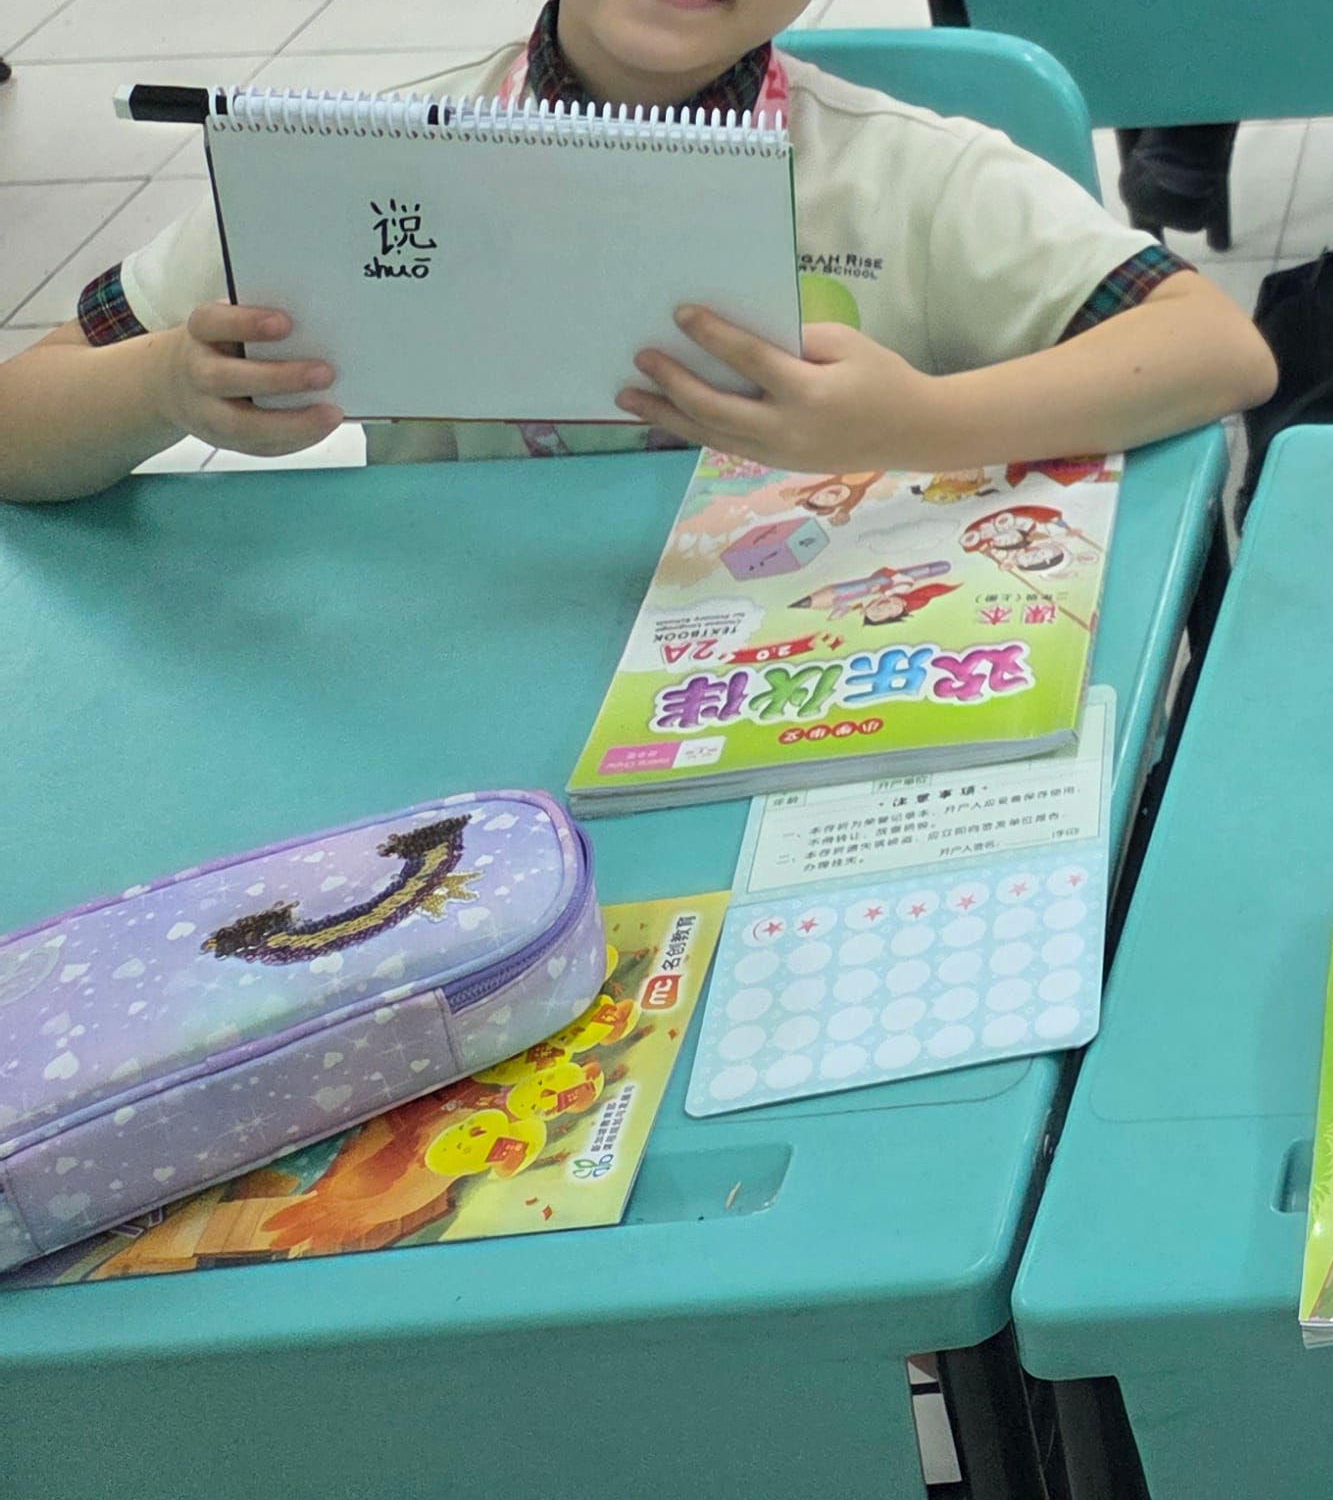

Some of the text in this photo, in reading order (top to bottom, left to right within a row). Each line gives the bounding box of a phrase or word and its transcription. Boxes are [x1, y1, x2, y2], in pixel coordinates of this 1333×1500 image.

[370, 198, 437, 255] 说
[364, 256, 432, 279] shuō
[977, 603, 1057, 626] 课本
[653, 626, 737, 642] TEXTBOOK
[664, 638, 719, 664] 2A
[656, 642, 1031, 730] 欢乐伙伴
[662, 915, 697, 971] 名创教育
